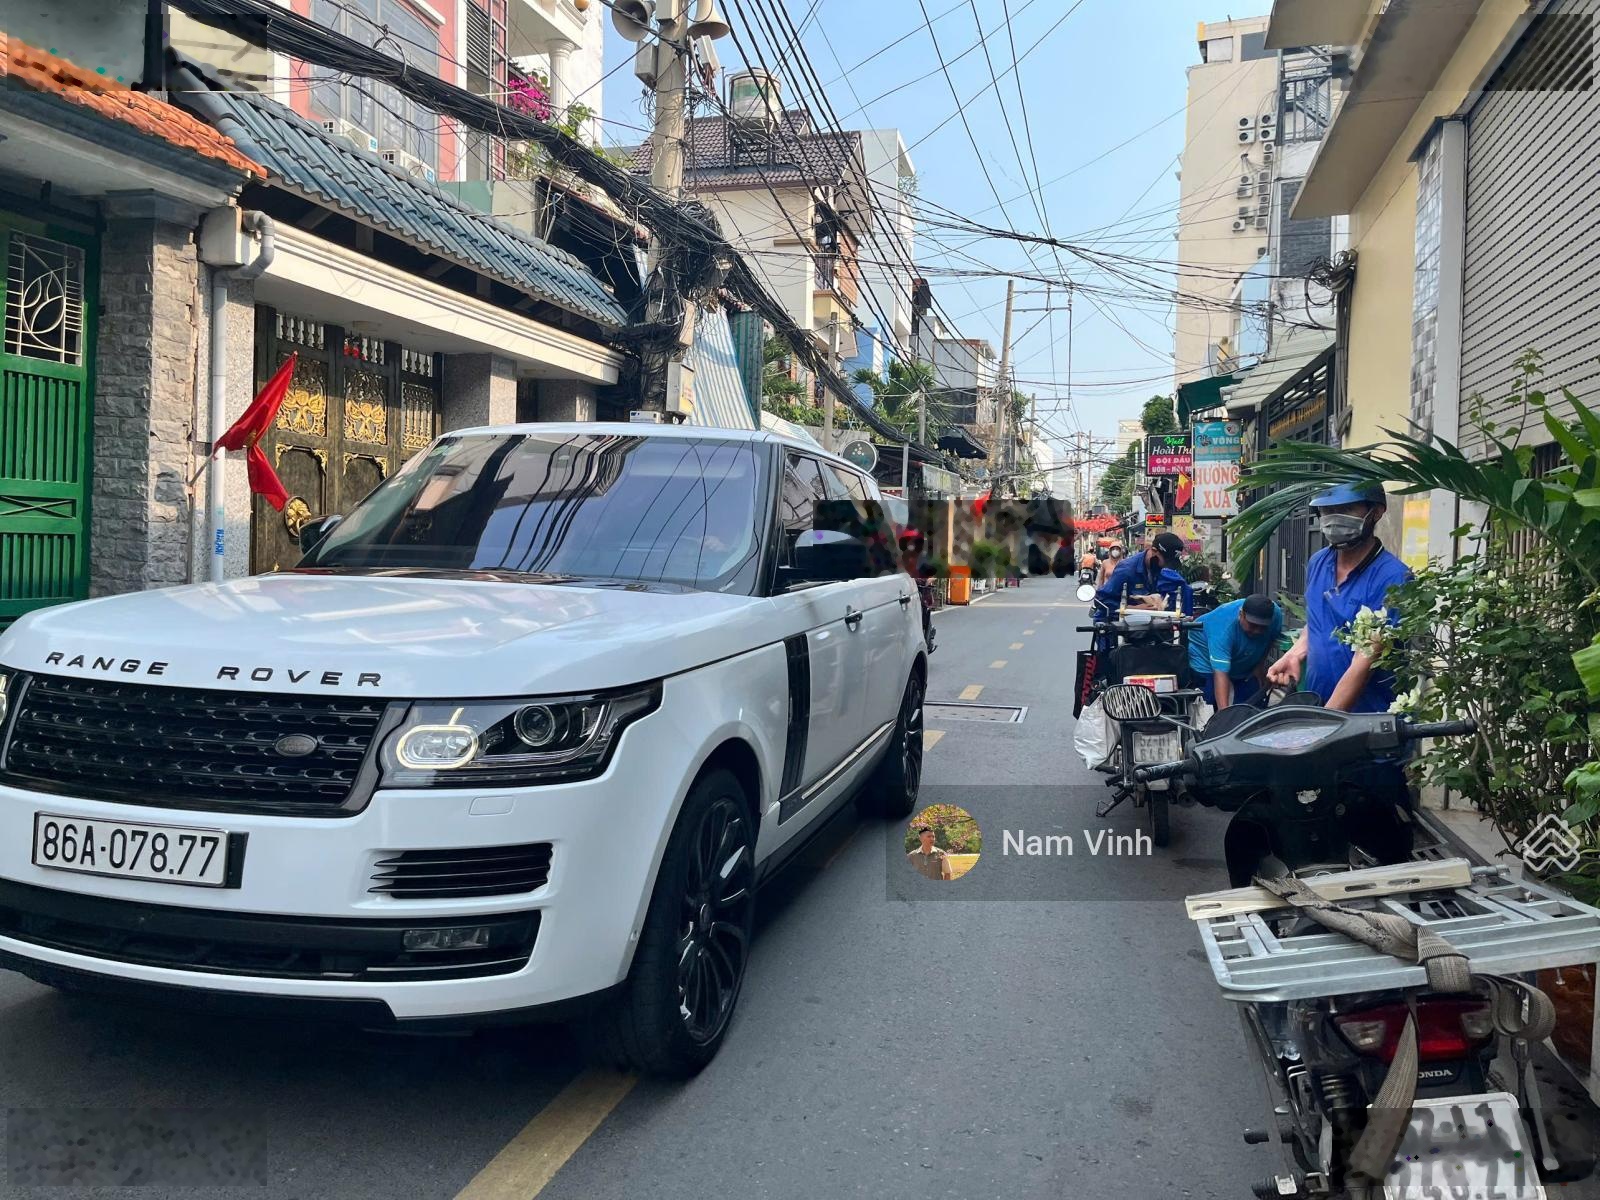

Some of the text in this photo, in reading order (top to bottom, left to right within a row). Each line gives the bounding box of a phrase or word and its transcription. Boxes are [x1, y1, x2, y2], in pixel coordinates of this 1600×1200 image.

[45, 651, 382, 687] RANGE ROVER
[43, 821, 220, 877] 86A-078.77
[1418, 1069, 1453, 1079] ONDA
